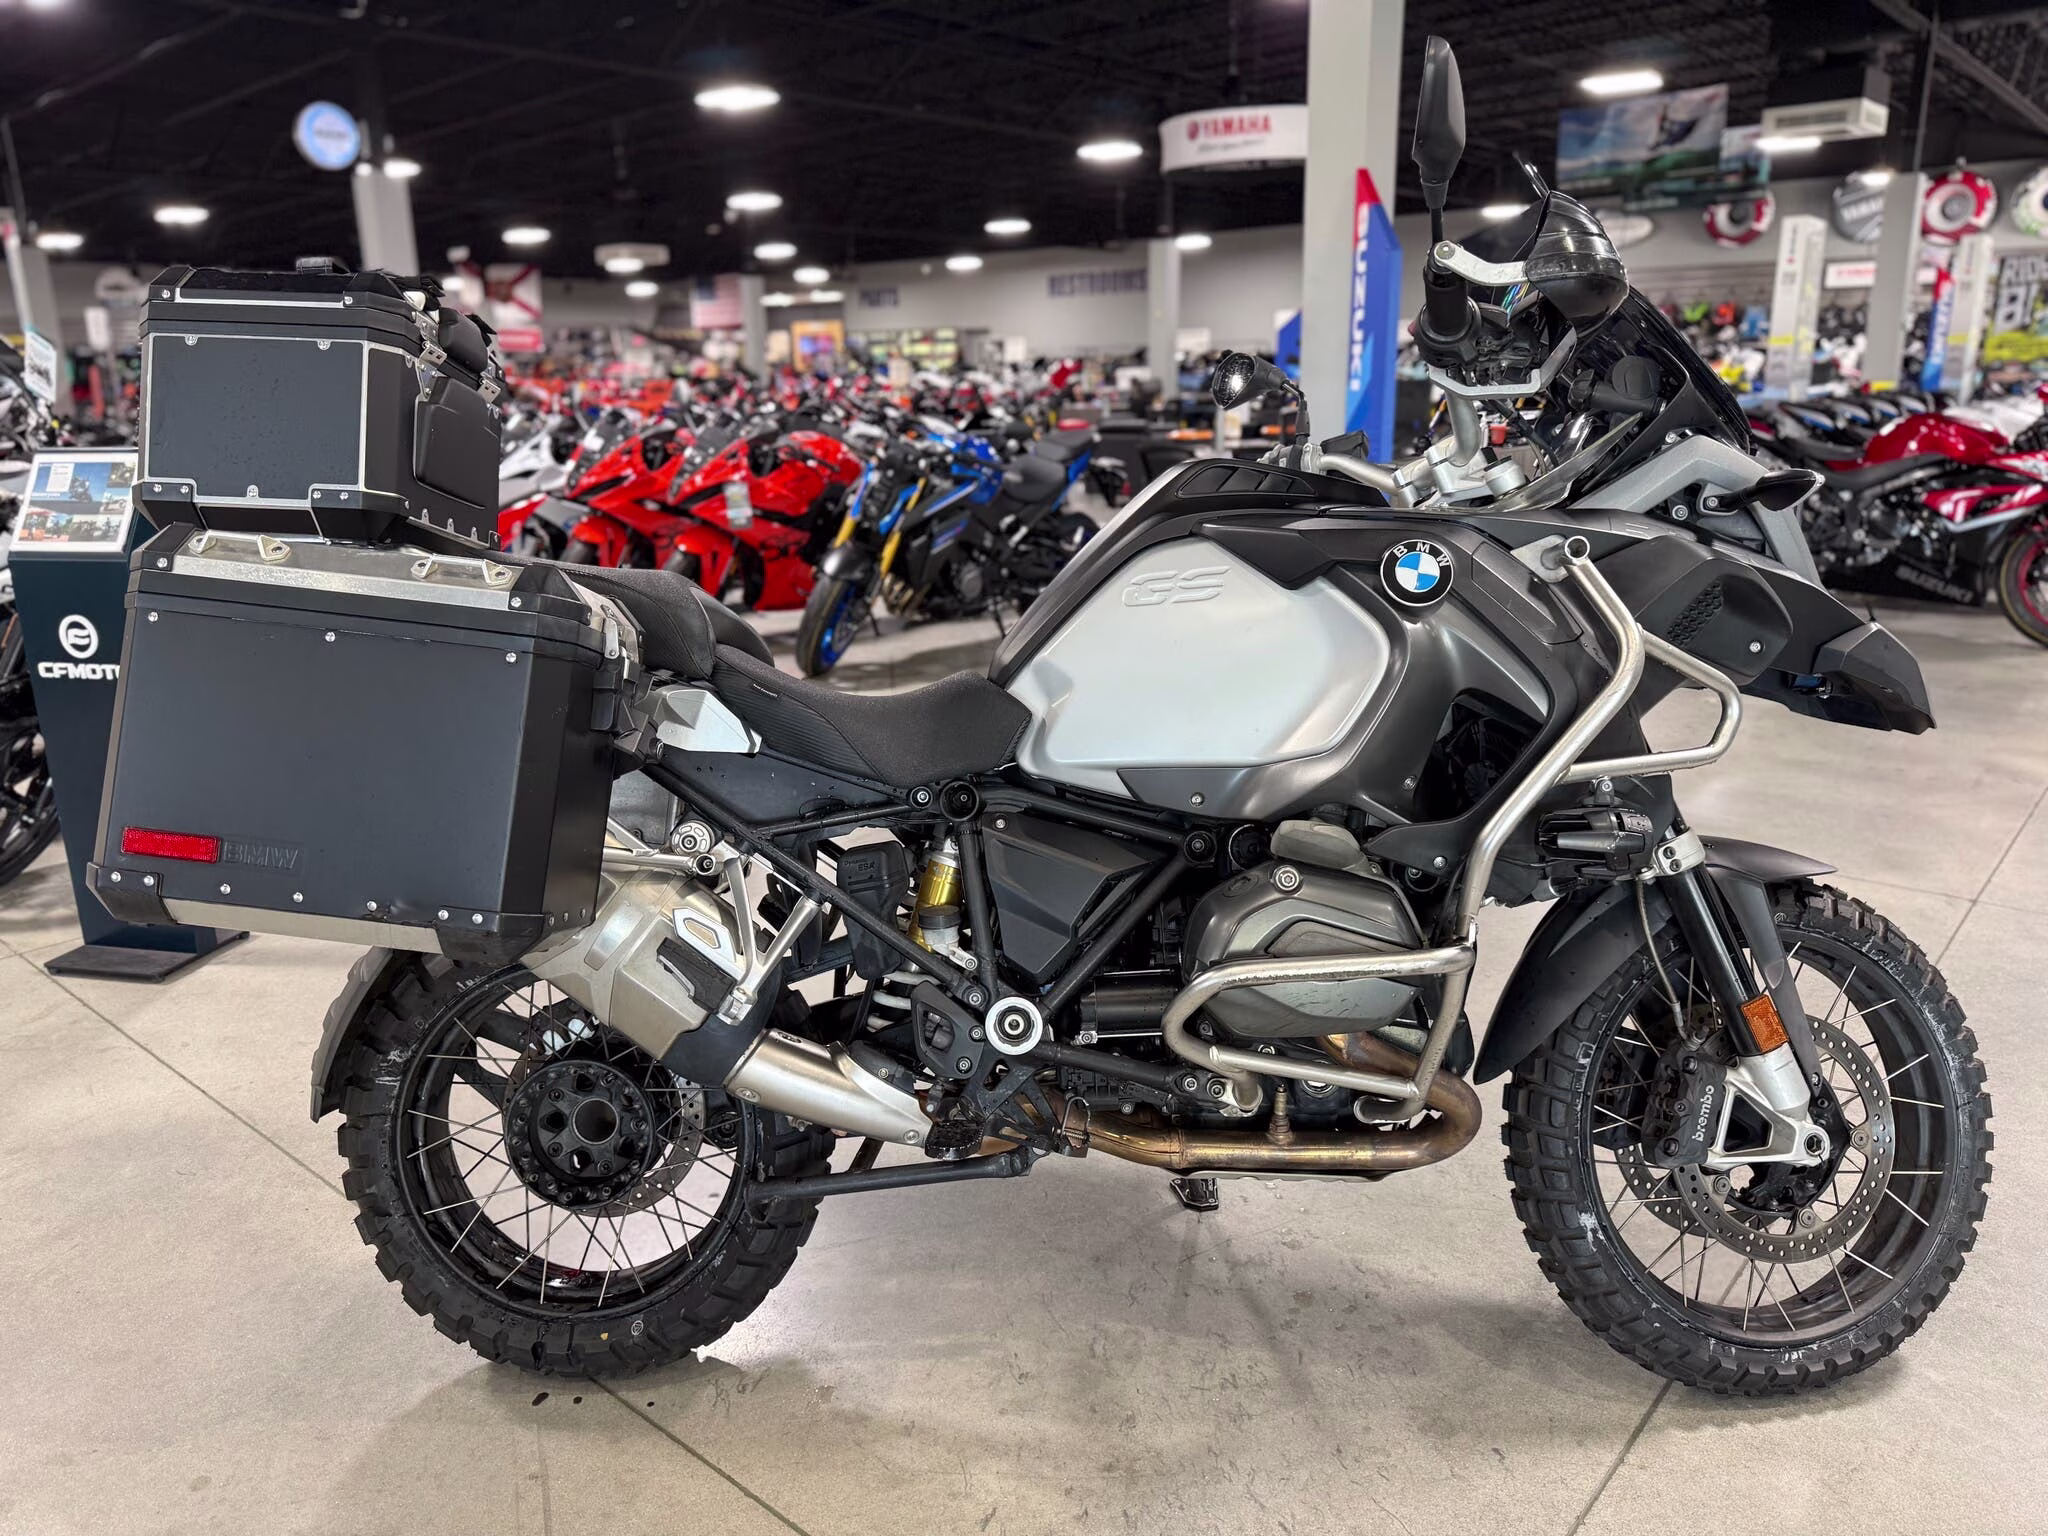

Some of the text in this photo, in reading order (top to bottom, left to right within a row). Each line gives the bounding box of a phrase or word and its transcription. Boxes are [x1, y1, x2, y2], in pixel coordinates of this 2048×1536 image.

[1203, 114, 1271, 138] YAMAHA
[1350, 202, 1370, 393] SUZUKI
[1393, 541, 1449, 567] BMW
[1122, 566, 1231, 607] GS
[1896, 565, 1974, 604] SUZUKI
[223, 841, 298, 869] BMW
[1691, 1085, 1714, 1142] brembo
